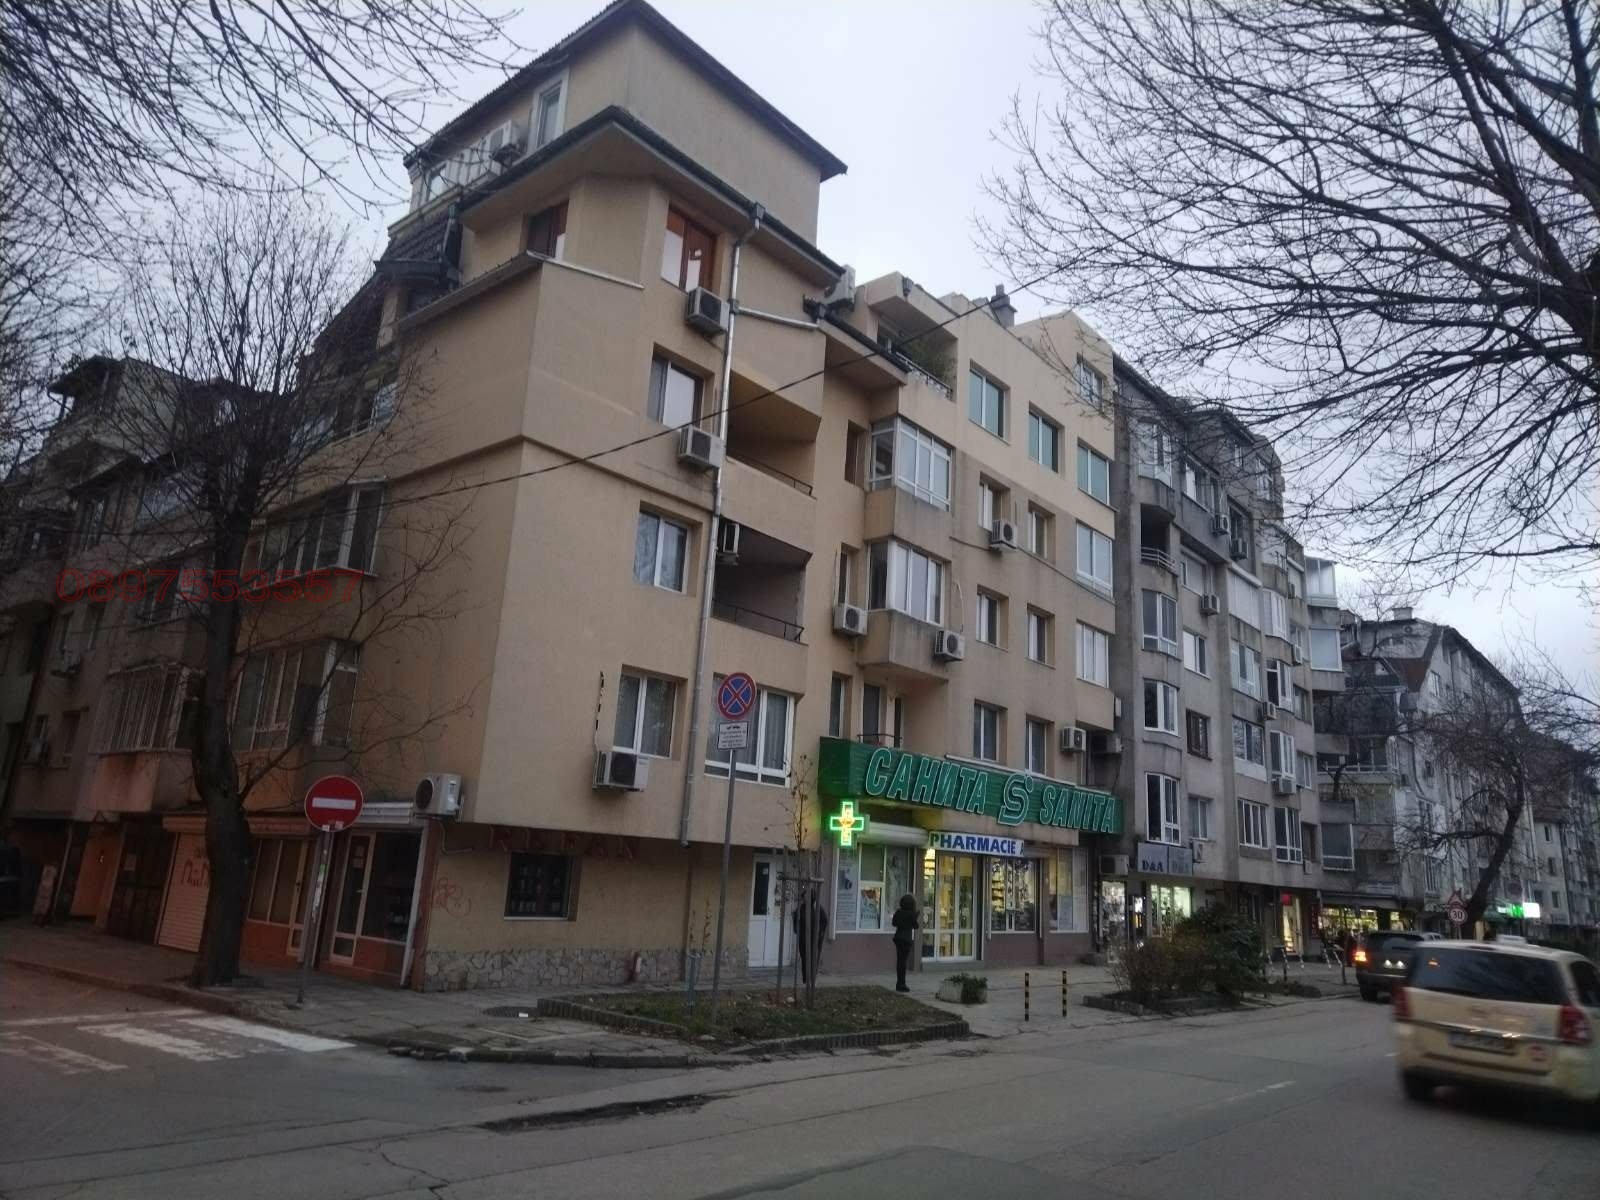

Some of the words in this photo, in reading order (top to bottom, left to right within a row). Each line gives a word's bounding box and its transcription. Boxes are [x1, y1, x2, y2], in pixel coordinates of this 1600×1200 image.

[866, 748, 988, 815] САНИТА
[1040, 785, 1116, 833] SANITA
[929, 833, 1016, 855] PHARMACIE
[1452, 910, 1463, 919] 30
